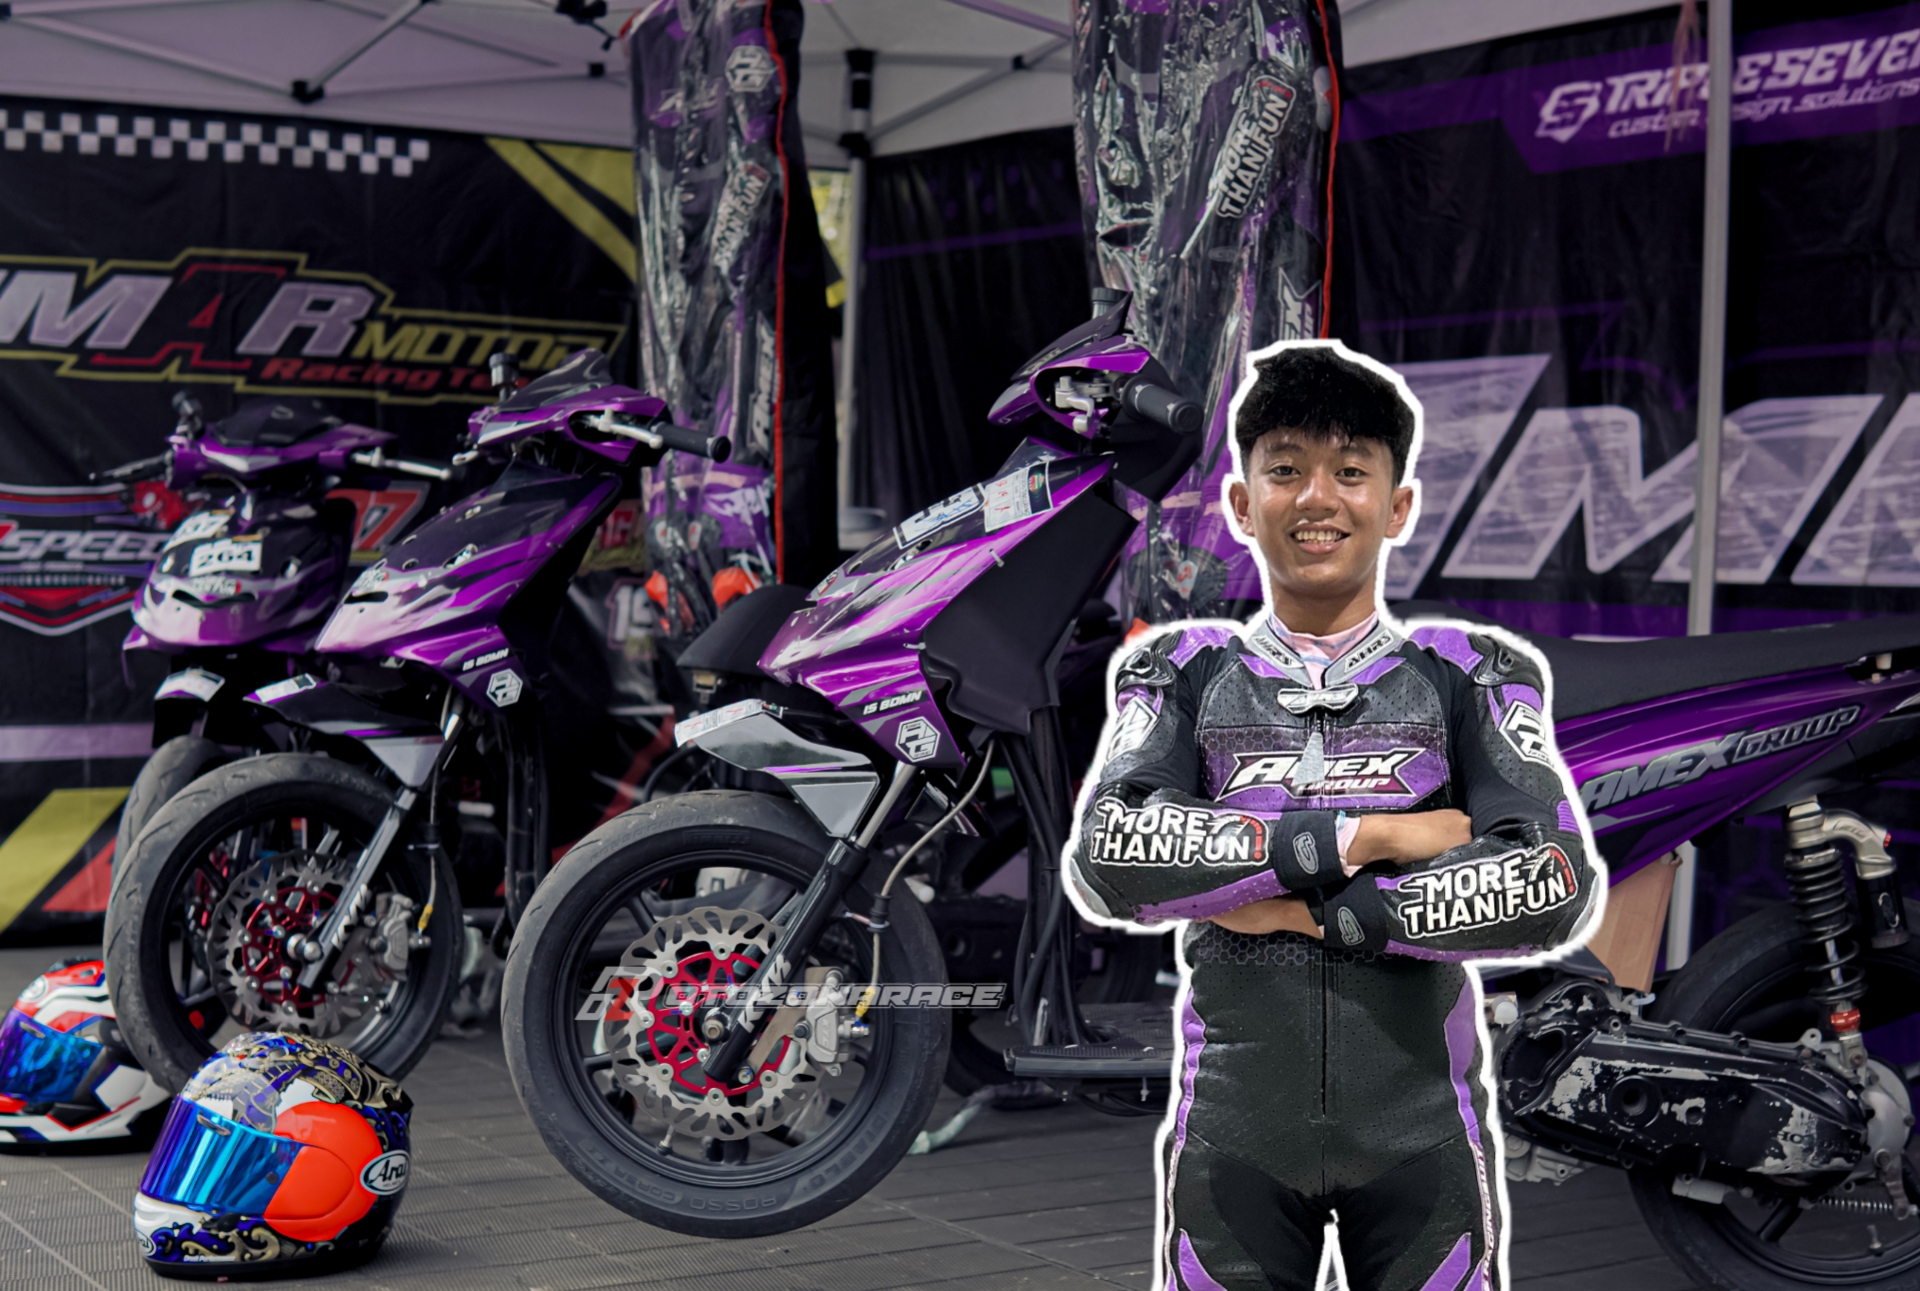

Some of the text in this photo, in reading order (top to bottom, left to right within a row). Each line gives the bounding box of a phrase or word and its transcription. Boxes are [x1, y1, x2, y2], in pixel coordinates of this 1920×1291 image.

[1218, 112, 1252, 193] MORE
[260, 356, 441, 391] Racing
[1348, 632, 1392, 668] AHRS
[1580, 704, 1861, 812] AMEX GROUP
[1100, 802, 1209, 836] MORE
[1092, 831, 1171, 862] THAN
[1411, 857, 1525, 903] MORE
[1404, 891, 1495, 934] THAN
[689, 1195, 777, 1213] ROSSO
